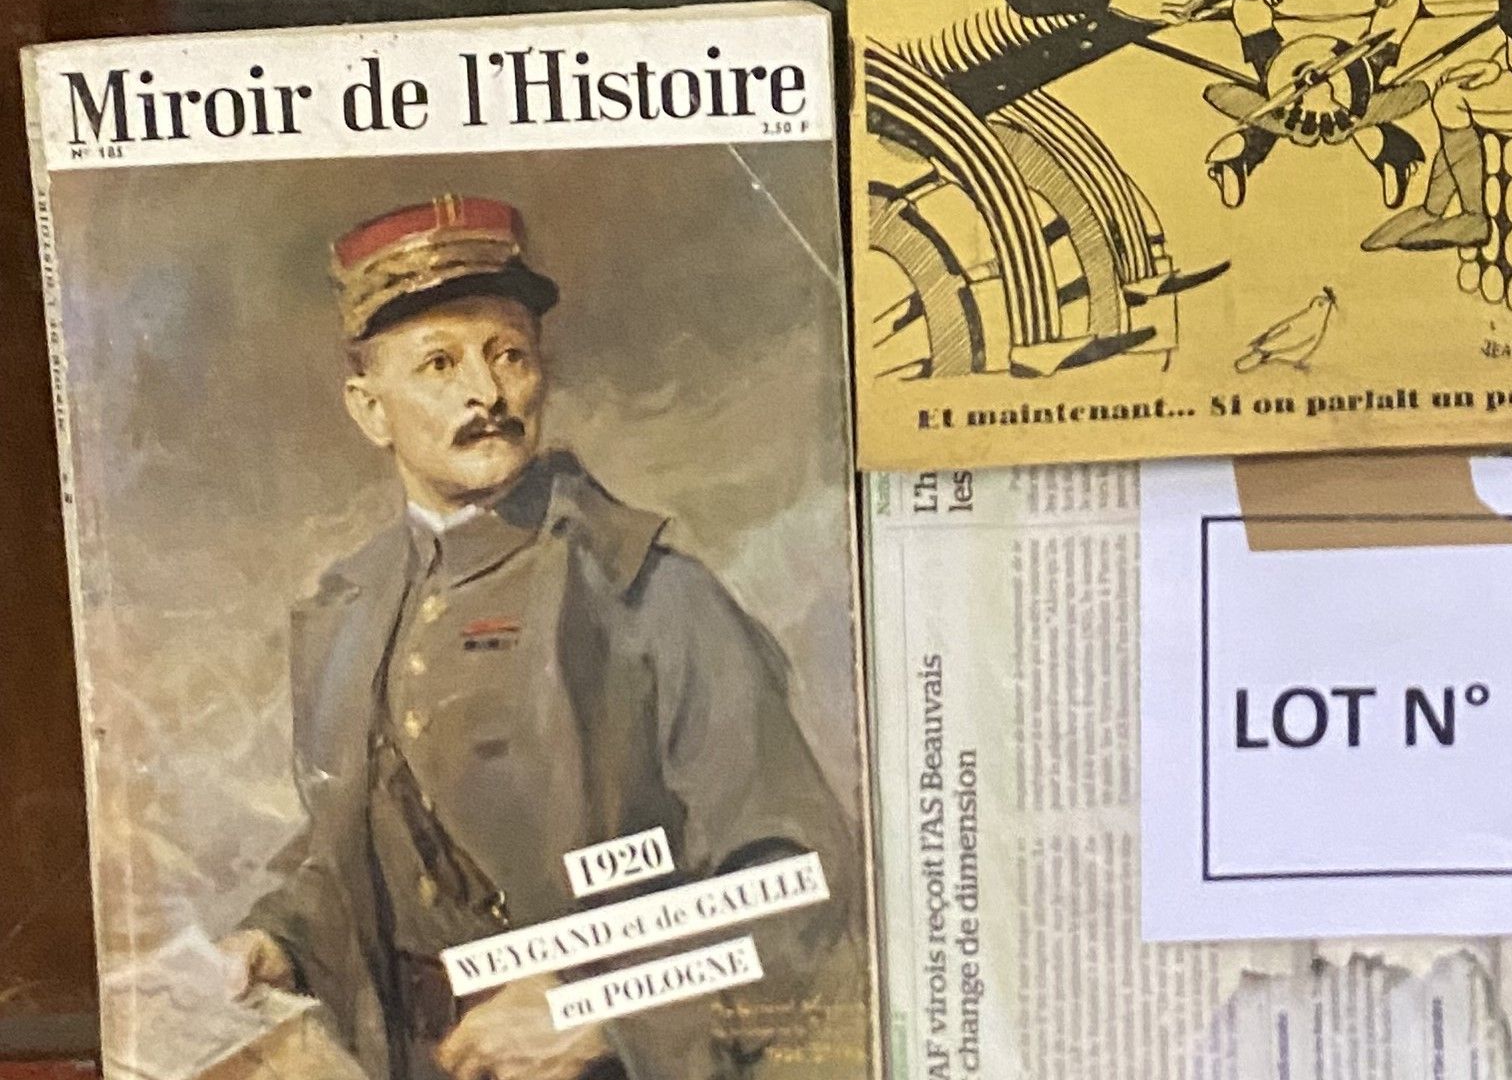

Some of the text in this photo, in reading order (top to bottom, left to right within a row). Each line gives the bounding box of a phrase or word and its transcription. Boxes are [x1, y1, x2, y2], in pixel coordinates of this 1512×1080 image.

[59, 45, 806, 145] Miroir de l'Histoire
[917, 407, 954, 430] Et
[966, 395, 1197, 428] maintenant...
[1209, 392, 1242, 418] Si
[1253, 395, 1295, 415] on
[1305, 387, 1419, 417] parlait
[1431, 390, 1475, 410] un
[914, 471, 937, 512] L'h
[948, 470, 973, 512] les
[917, 653, 944, 791] Beauvais
[1235, 685, 1377, 749] LOT
[1404, 683, 1490, 746] N°
[577, 836, 664, 888] 1920
[922, 858, 949, 945] reçoit
[456, 865, 821, 982] WEYGAND et de GAULLE
[954, 746, 984, 1073] change de dimension
[559, 947, 751, 1020] en POLOGNE
[925, 949, 946, 1035] virois
